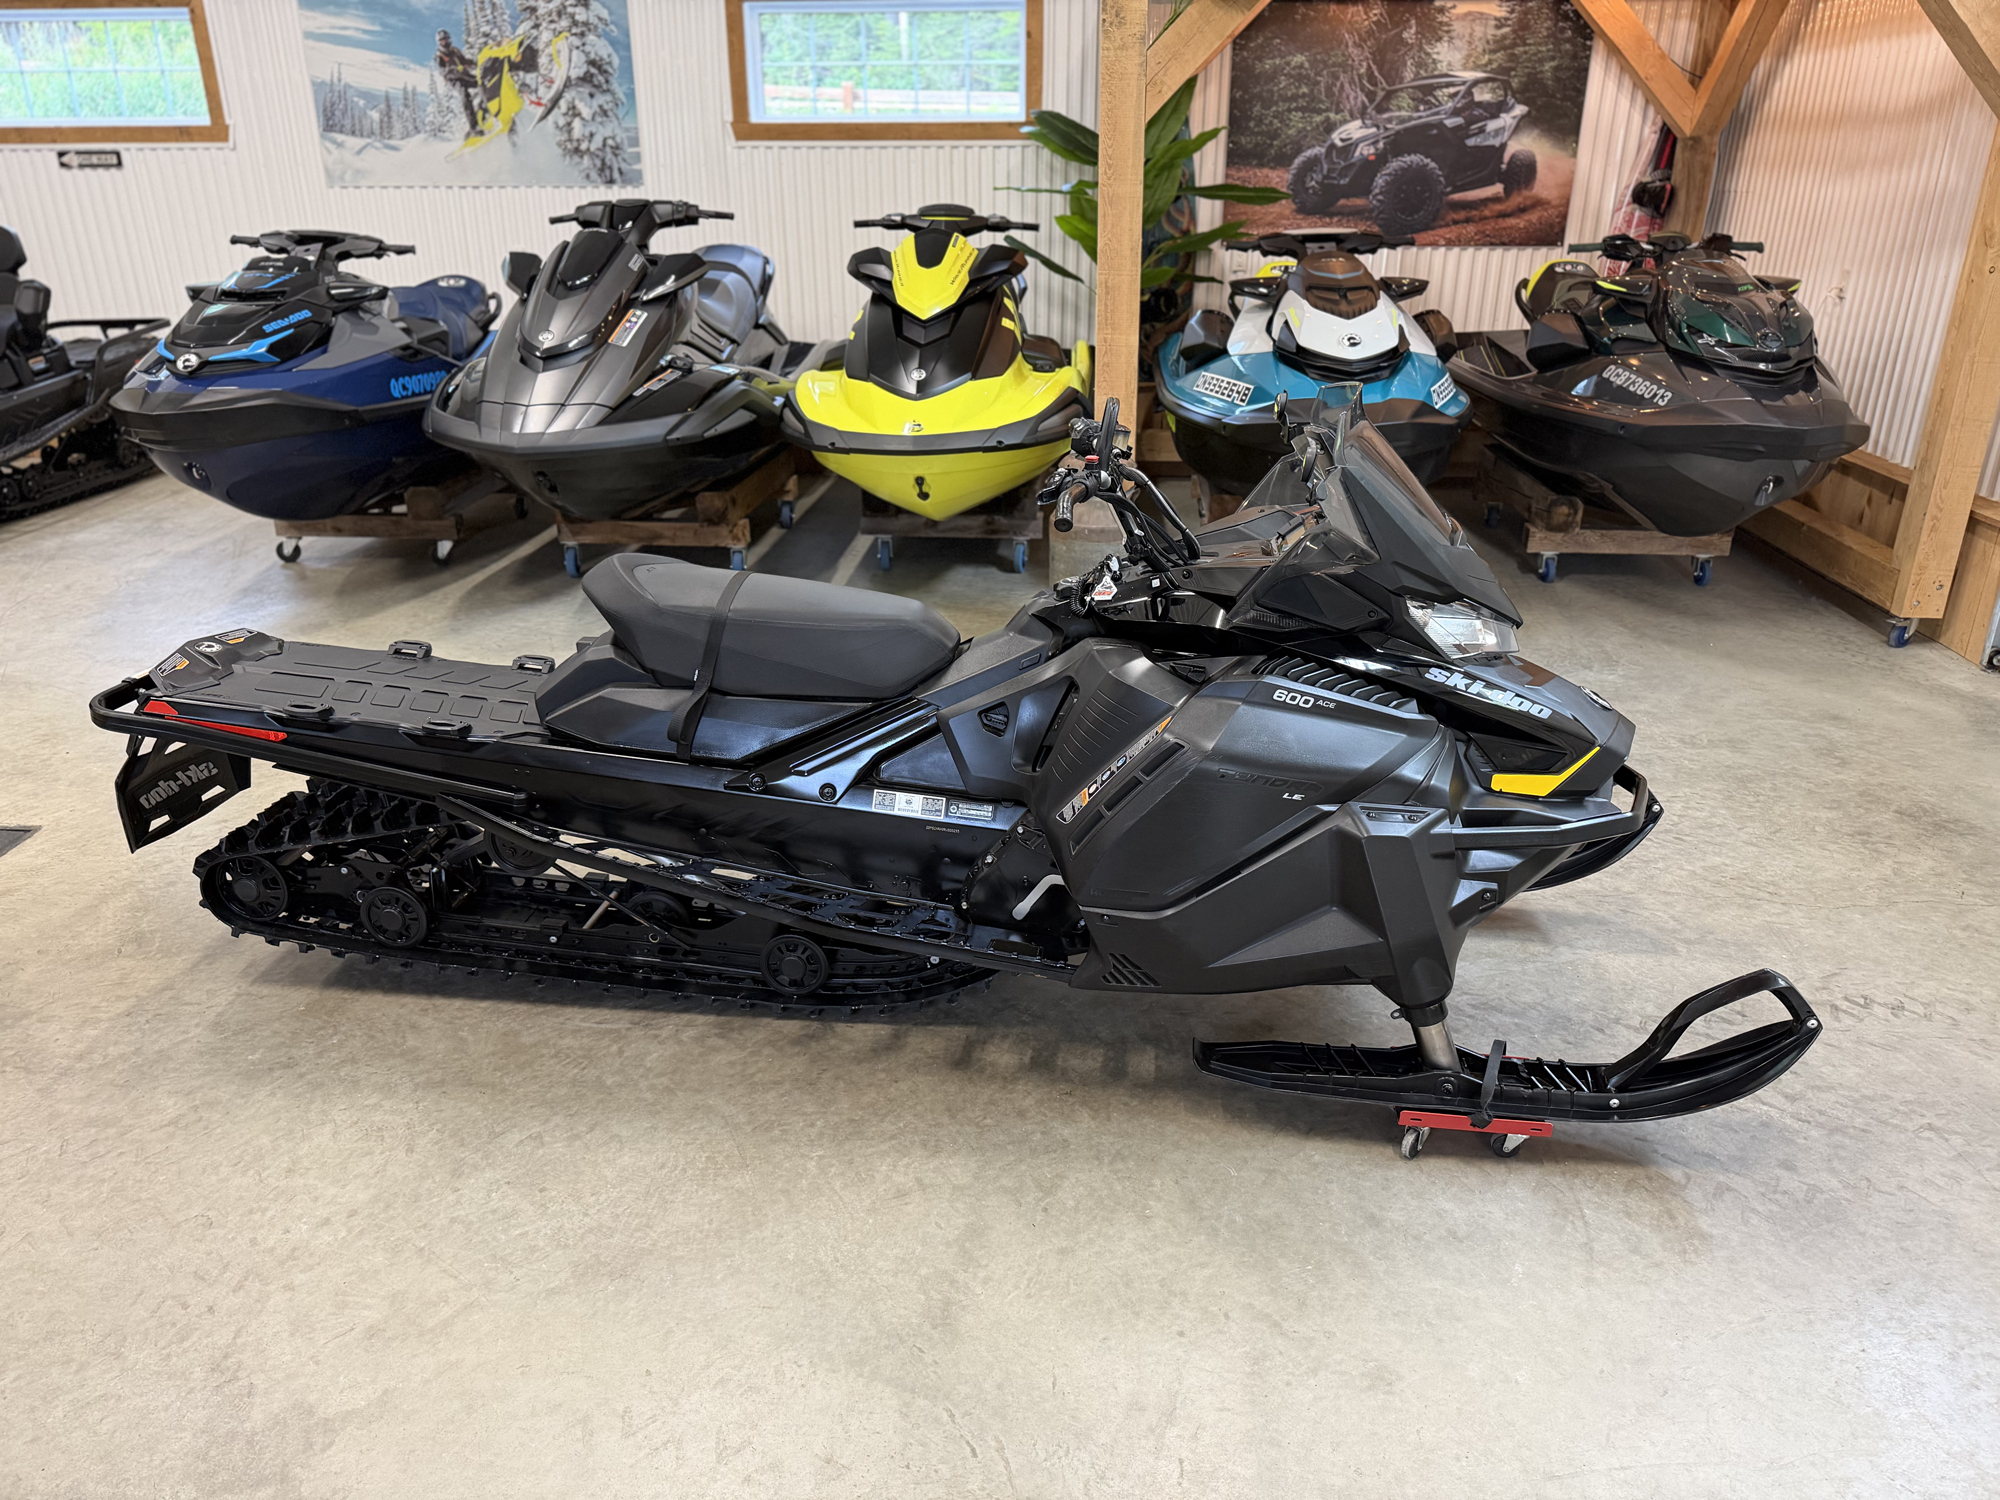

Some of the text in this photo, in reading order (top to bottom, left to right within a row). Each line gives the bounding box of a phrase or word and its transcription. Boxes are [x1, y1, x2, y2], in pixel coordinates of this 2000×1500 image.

[1601, 364, 1673, 407] QC8736013
[1272, 689, 1337, 709] 600 ACE
[1282, 792, 1306, 801] LE
